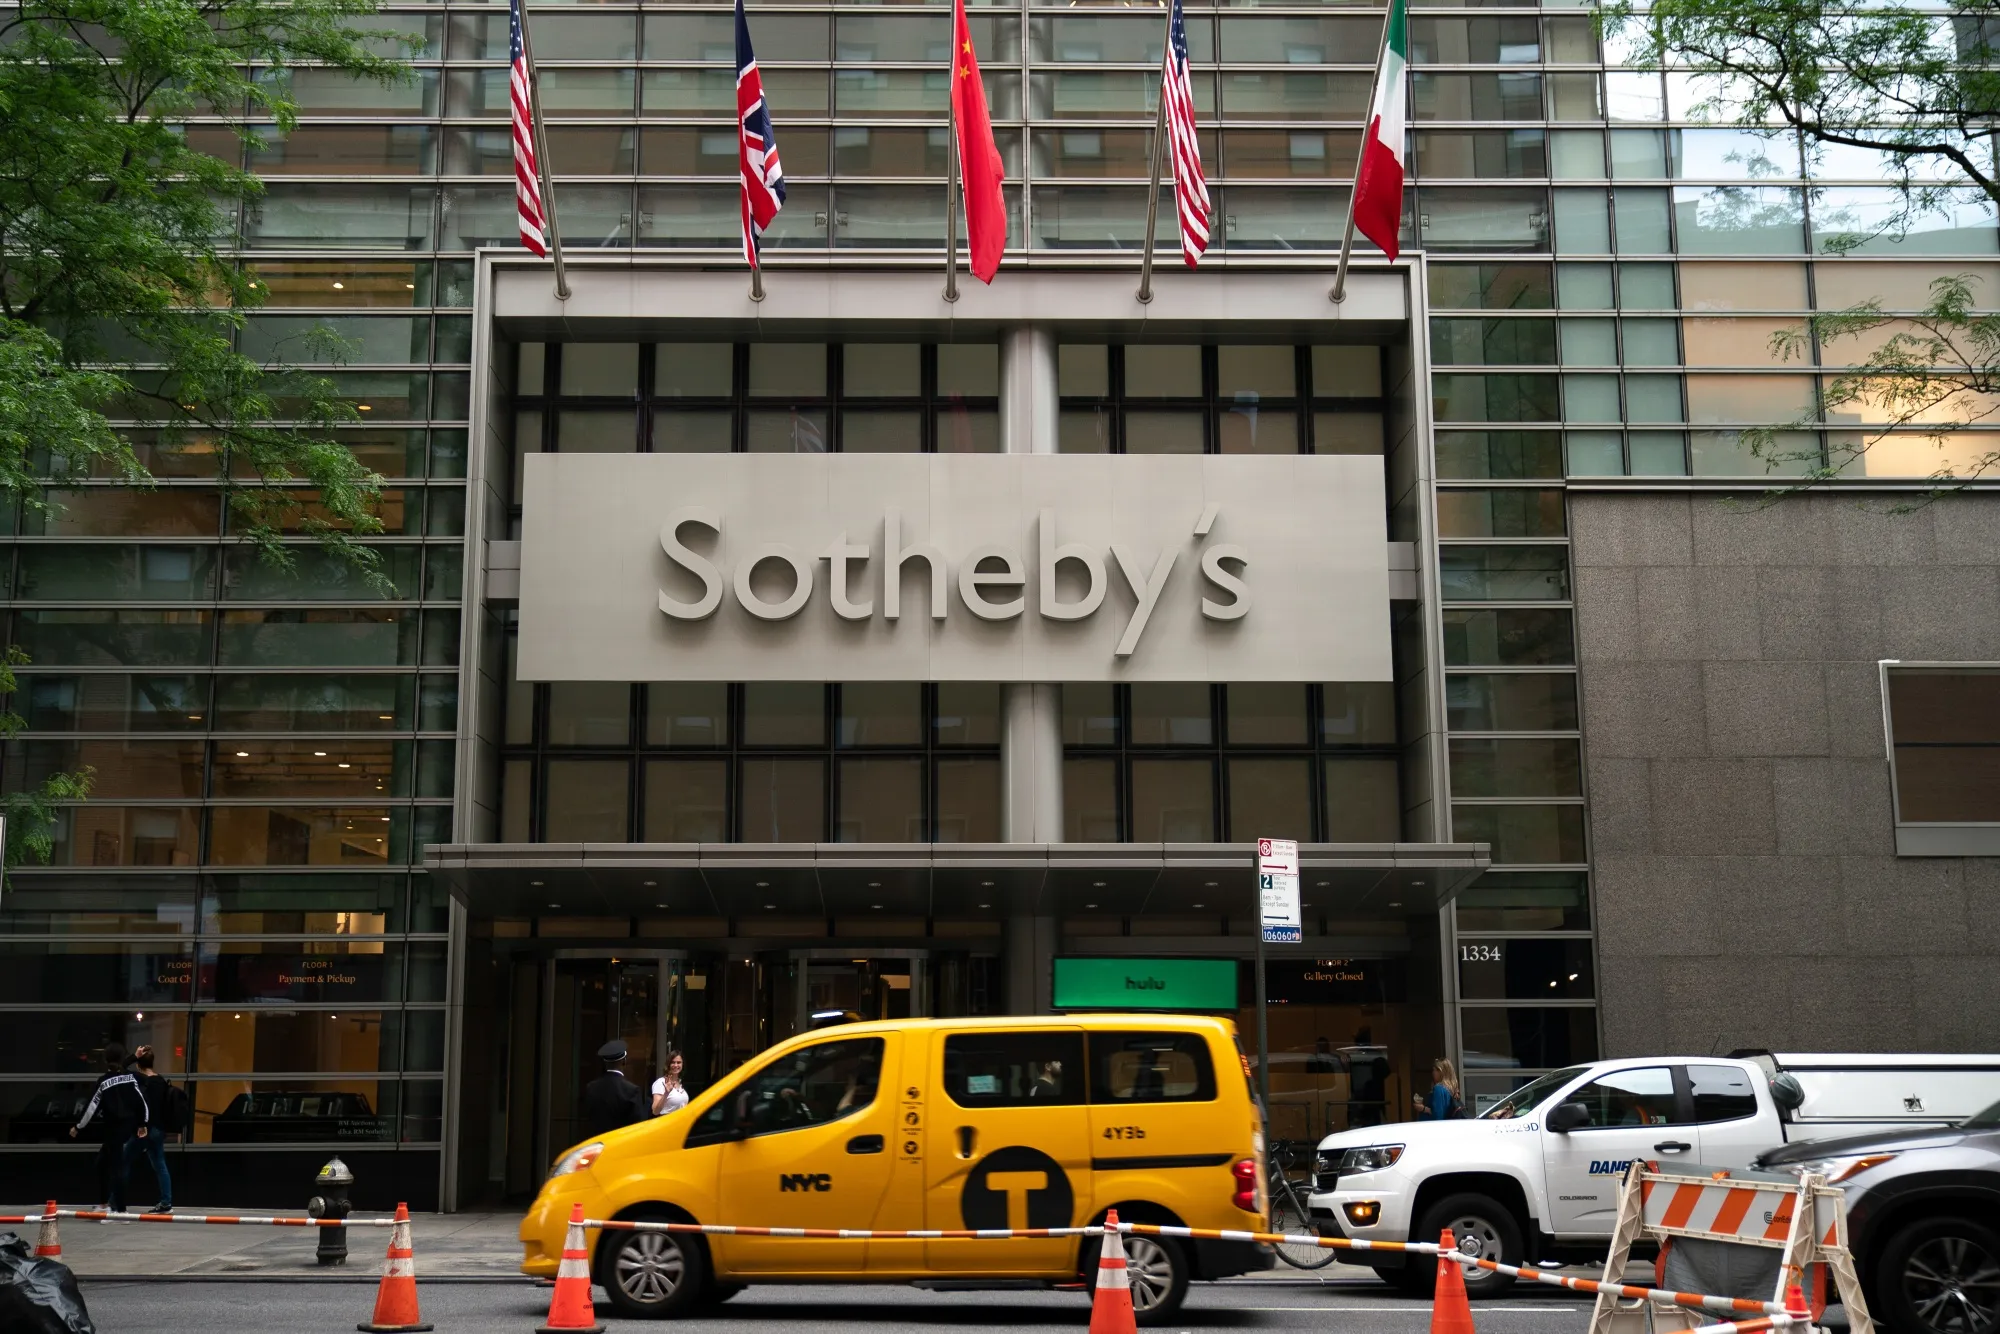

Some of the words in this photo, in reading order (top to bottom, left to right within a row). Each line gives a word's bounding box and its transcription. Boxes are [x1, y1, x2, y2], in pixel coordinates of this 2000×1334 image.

[658, 502, 1251, 657] Sotheby's
[1263, 875, 1270, 888] 2
[1263, 930, 1292, 940] 106060
[1461, 945, 1502, 961] 1334
[158, 974, 177, 984] Coat
[279, 974, 316, 984] Payment
[317, 975, 325, 983] &
[326, 973, 356, 985] Pickup
[1125, 976, 1166, 990] hulu
[1304, 971, 1333, 983] Gallery
[1335, 971, 1364, 981] Closed
[780, 1173, 832, 1192] NYC
